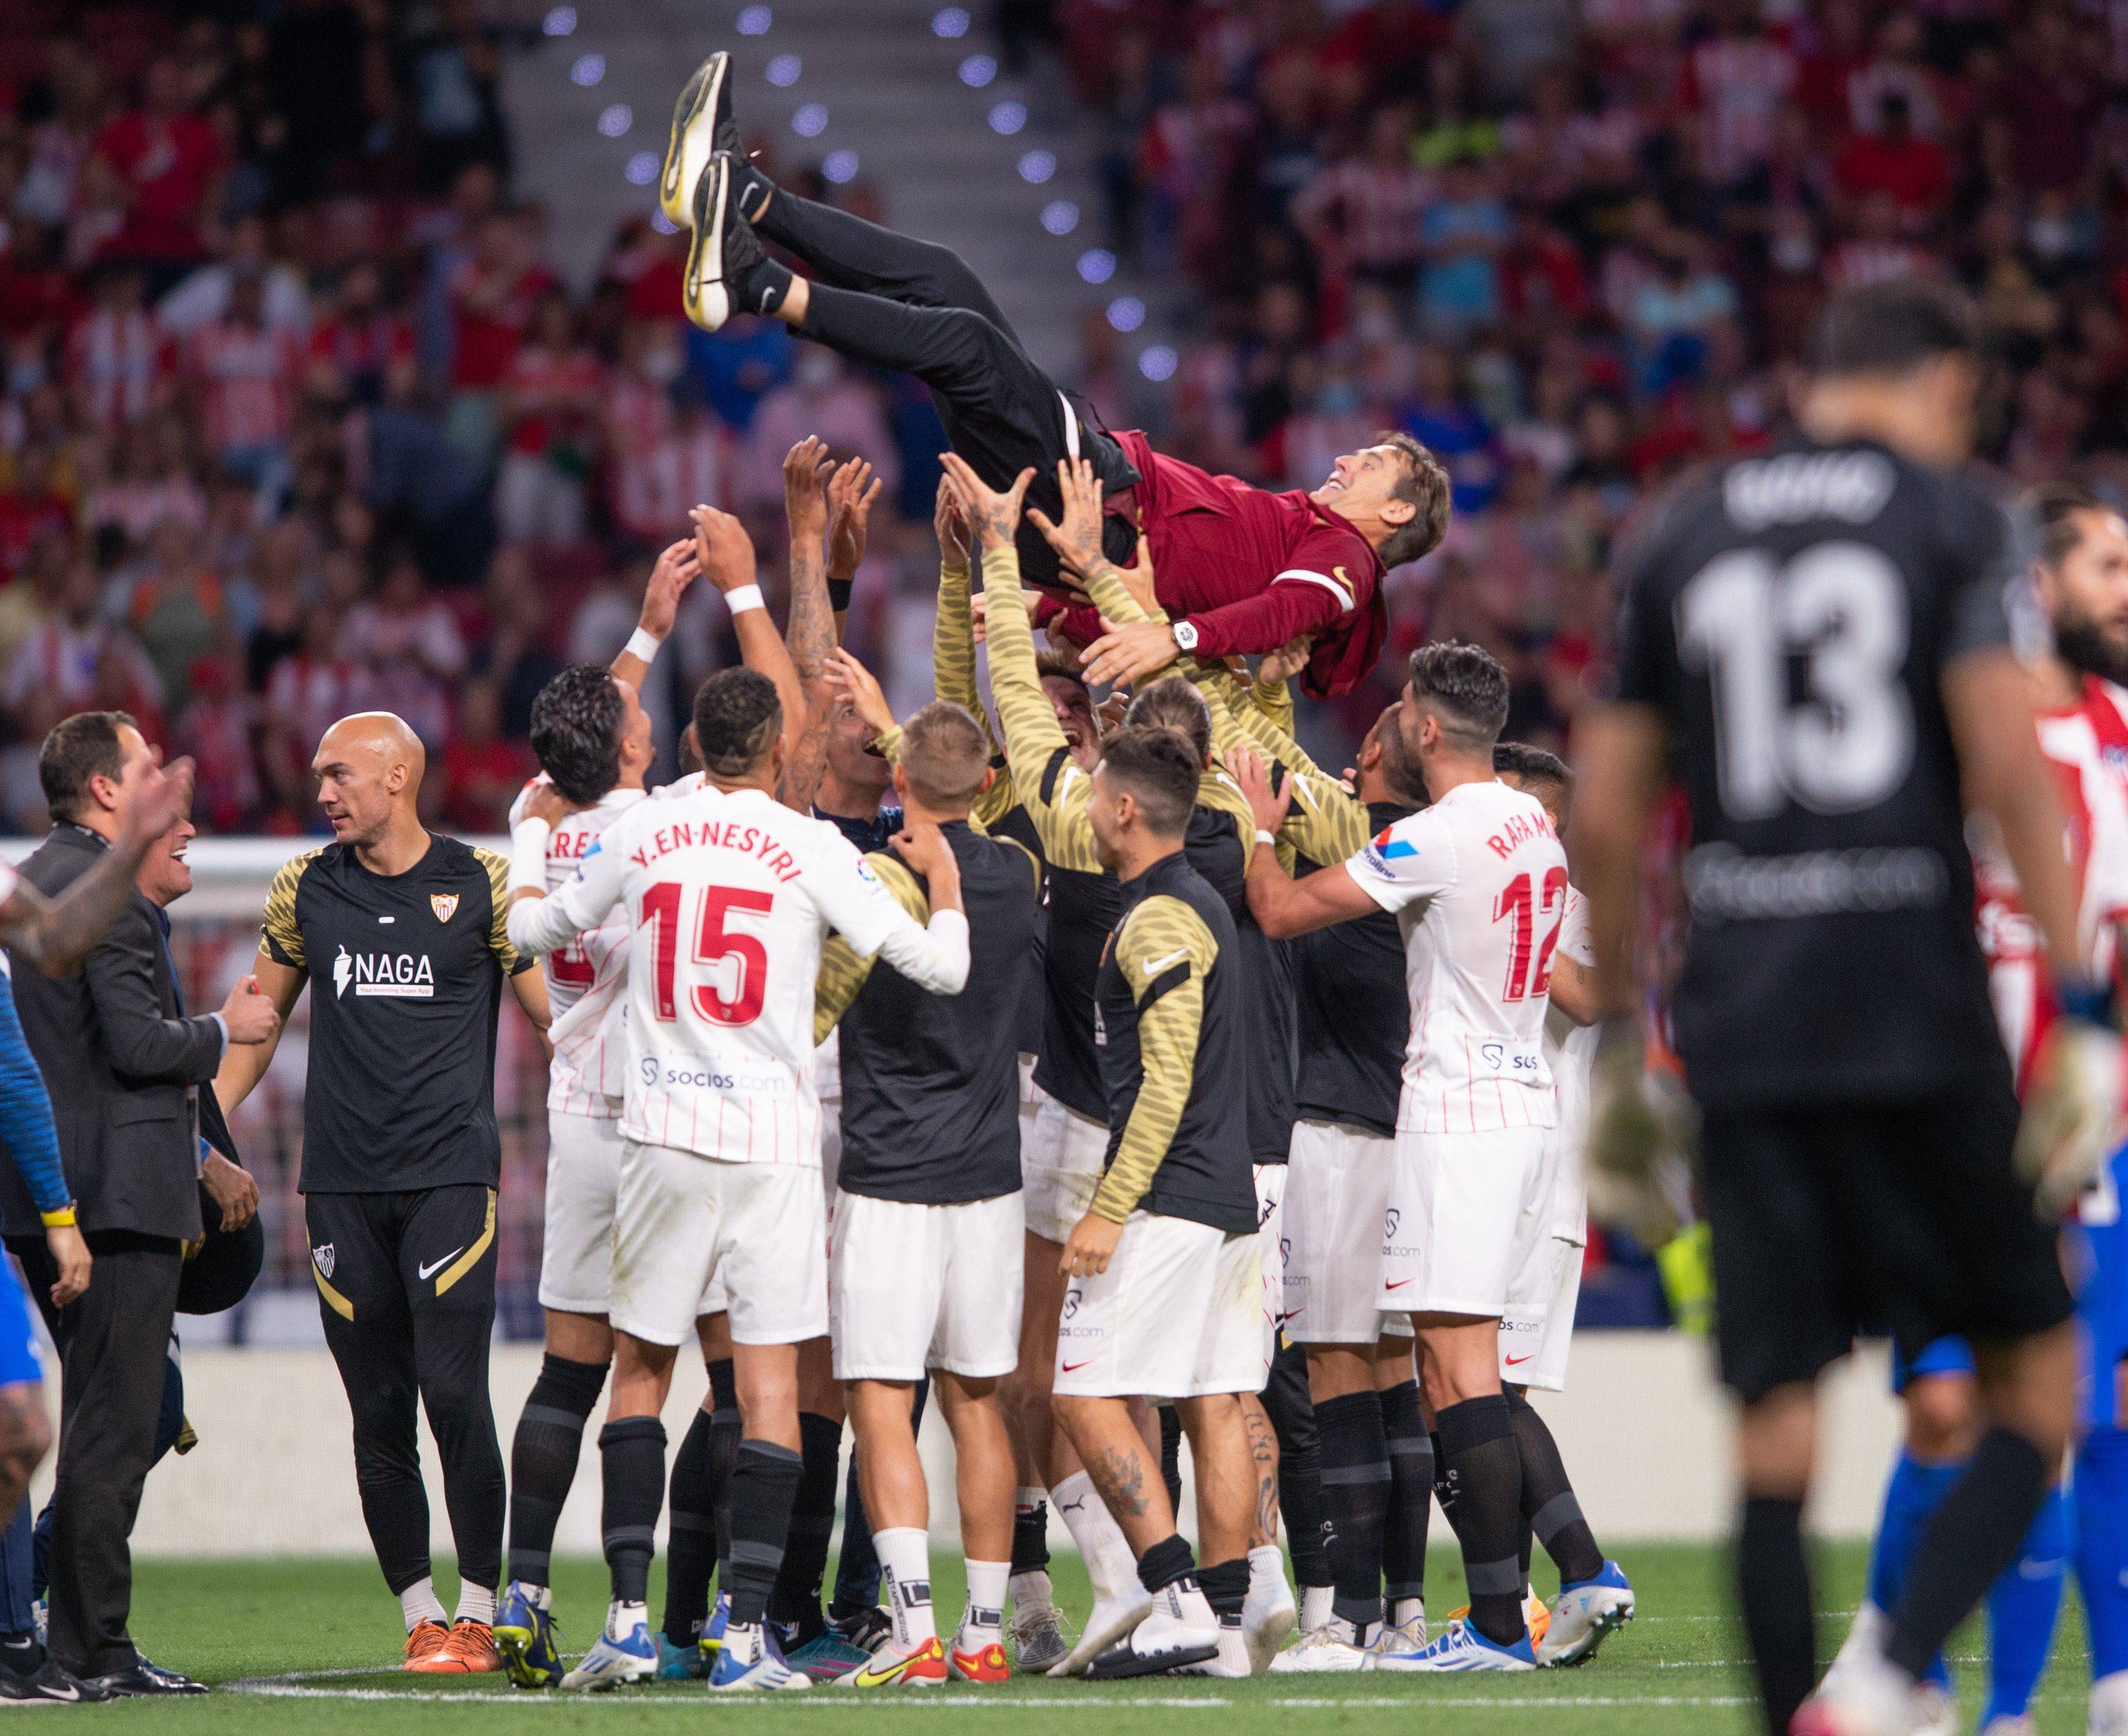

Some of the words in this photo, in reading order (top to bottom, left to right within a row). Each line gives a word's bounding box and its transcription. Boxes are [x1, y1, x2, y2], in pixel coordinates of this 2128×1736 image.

[1675, 543, 1915, 821] 13
[1487, 815, 1534, 861] RAFA
[356, 953, 434, 983] NAGA
[637, 881, 774, 1028] 15
[1492, 866, 1568, 1002] 12
[1497, 1321, 1538, 1332] os.com
